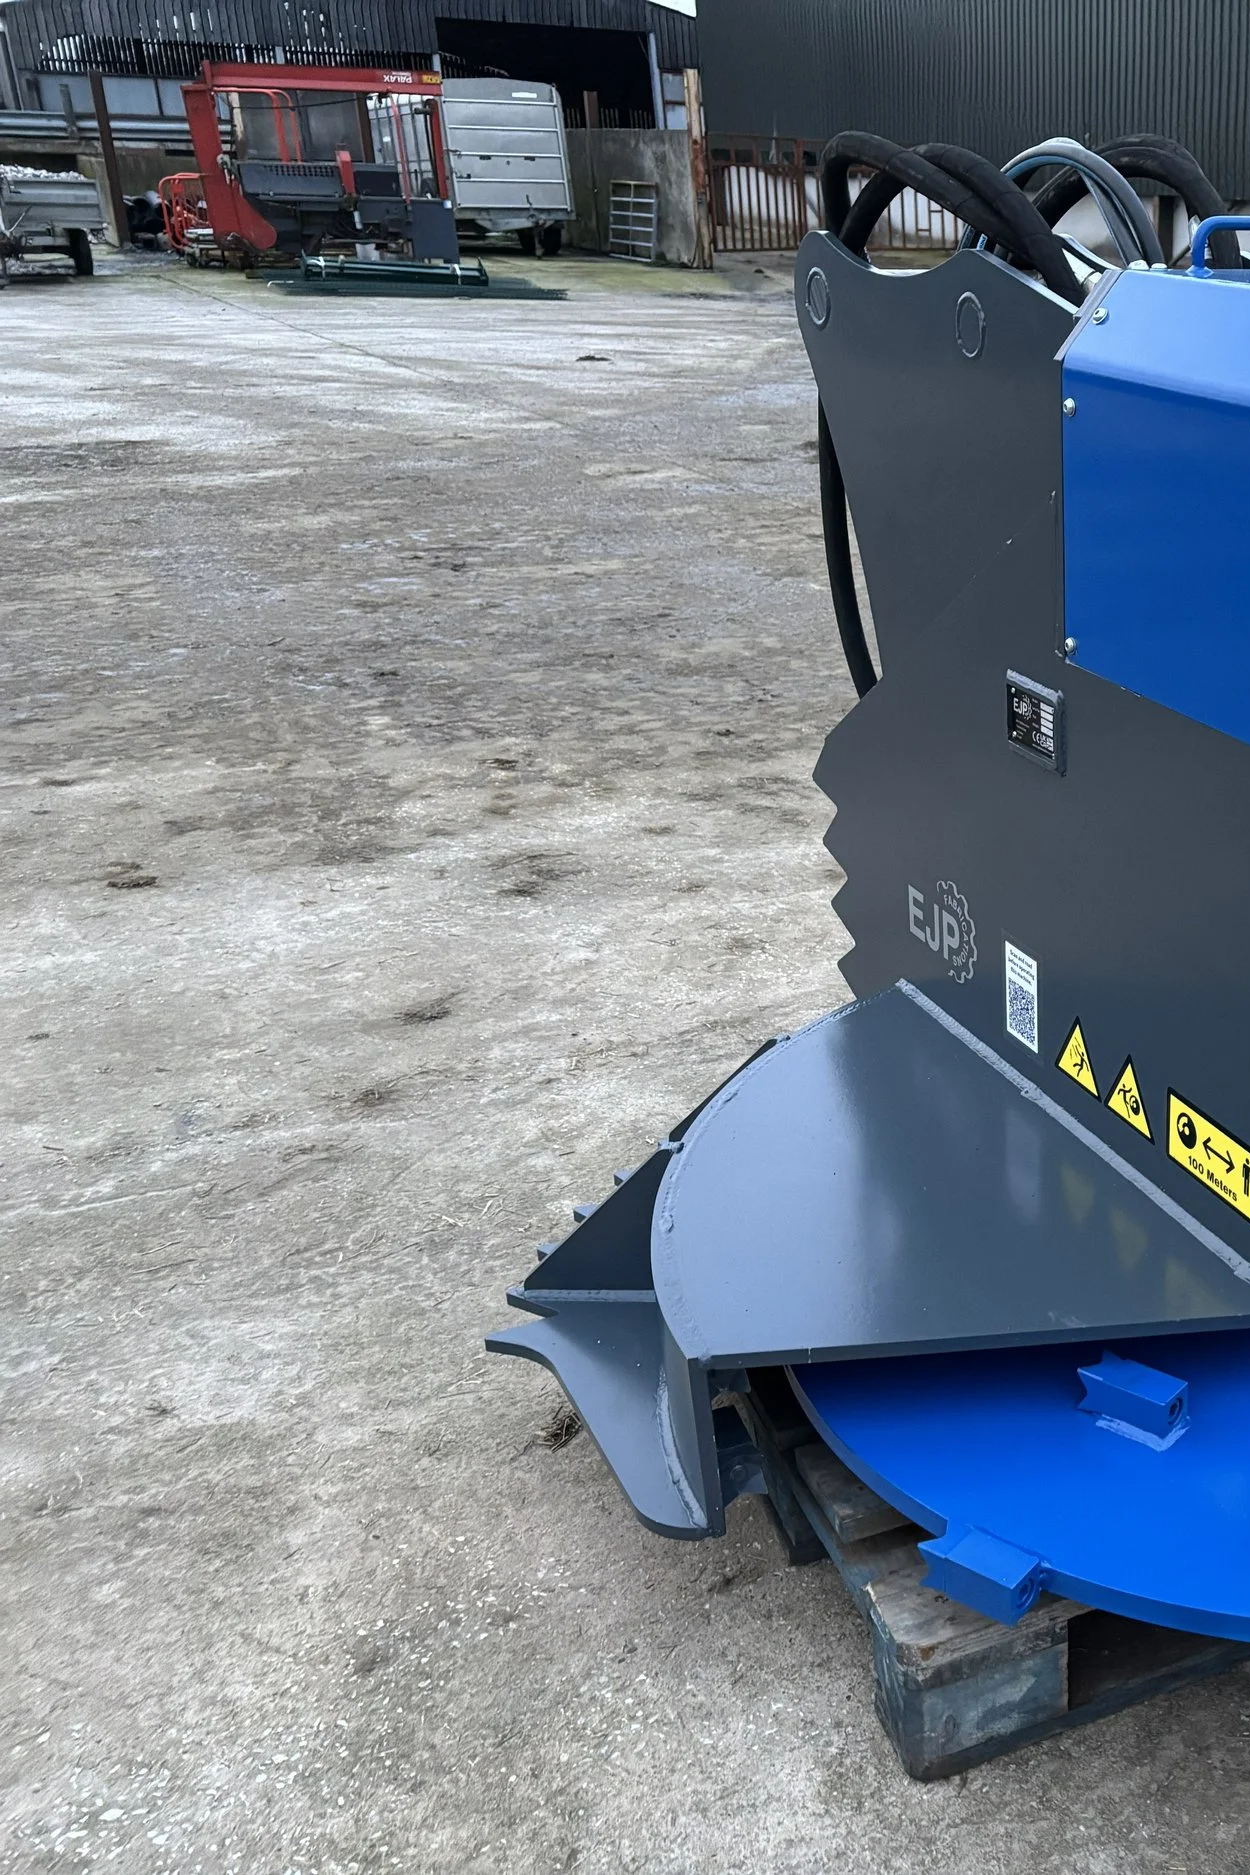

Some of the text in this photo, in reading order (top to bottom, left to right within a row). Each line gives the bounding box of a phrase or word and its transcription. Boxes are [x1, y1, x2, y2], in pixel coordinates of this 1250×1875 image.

[383, 75, 412, 84] PALAX
[1013, 697, 1028, 716] EJP
[908, 884, 960, 961] EJP
[943, 894, 969, 967] FABRICATIONS
[1188, 1155, 1237, 1202] 100 Meters
